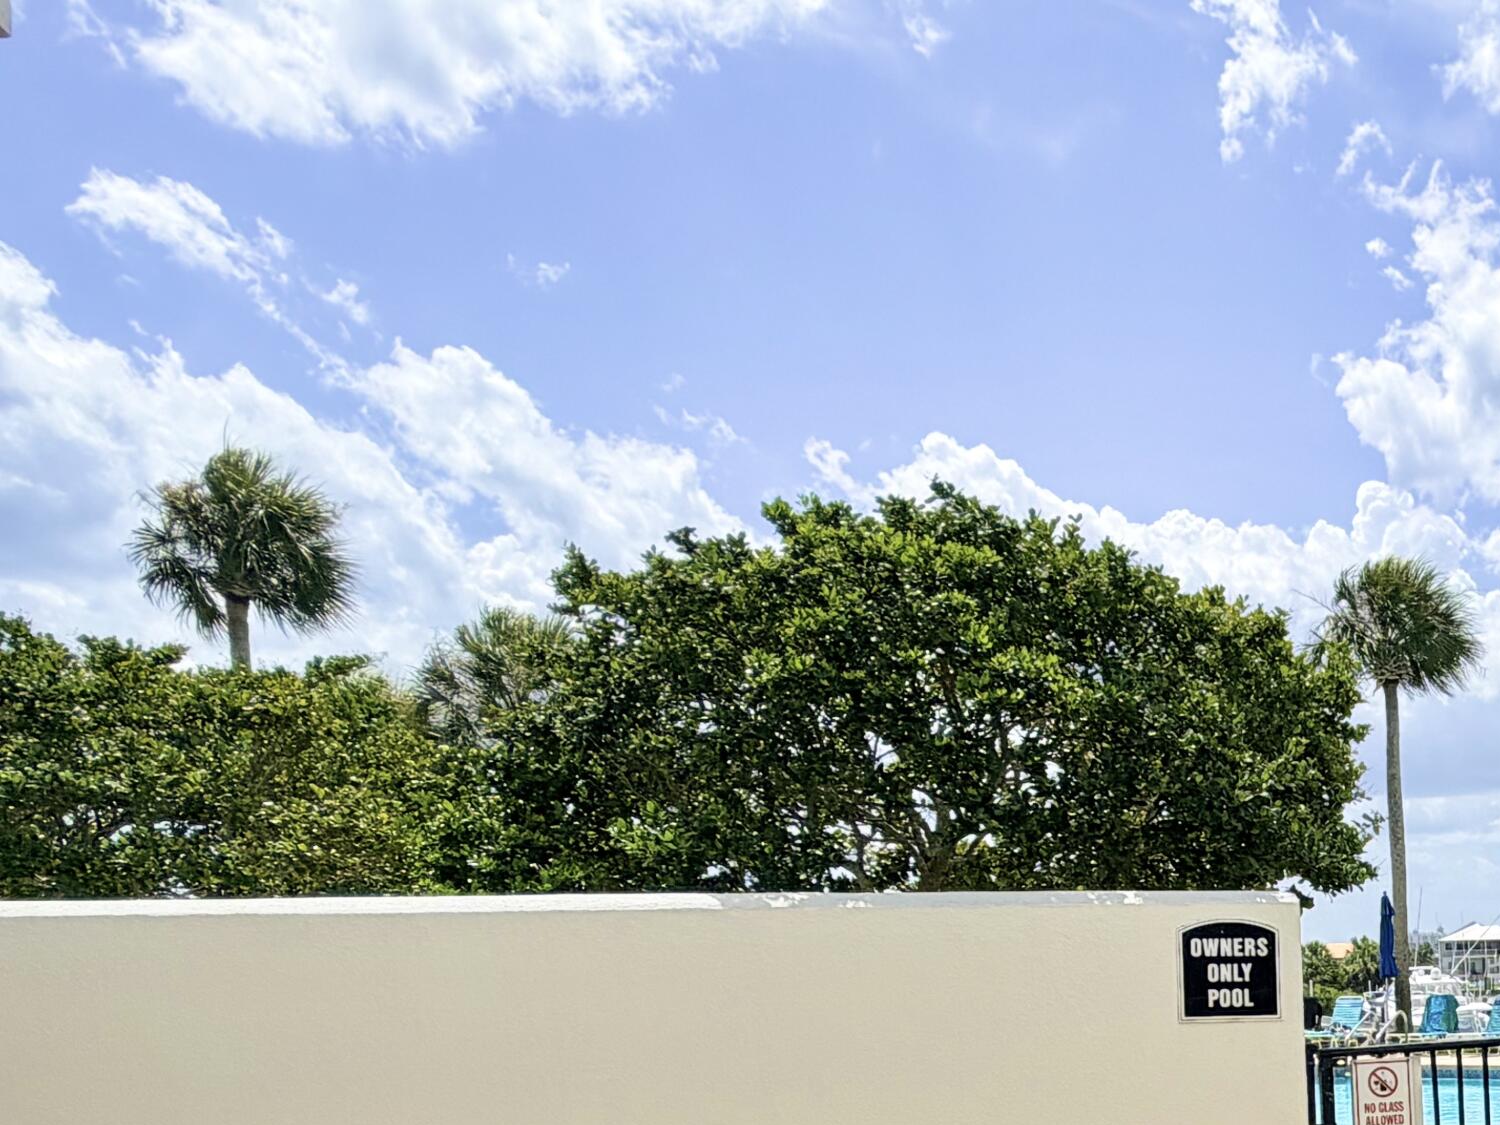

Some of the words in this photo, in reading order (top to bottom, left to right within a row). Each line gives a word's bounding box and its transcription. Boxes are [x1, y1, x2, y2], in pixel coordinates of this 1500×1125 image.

[1190, 937, 1269, 957] OWNERS
[1207, 962, 1252, 983] ONLY
[1207, 988, 1254, 1008] POOL
[1364, 1103, 1376, 1114] NO
[1378, 1101, 1404, 1113] GLASS
[1366, 1114, 1404, 1125] ALLOWED
